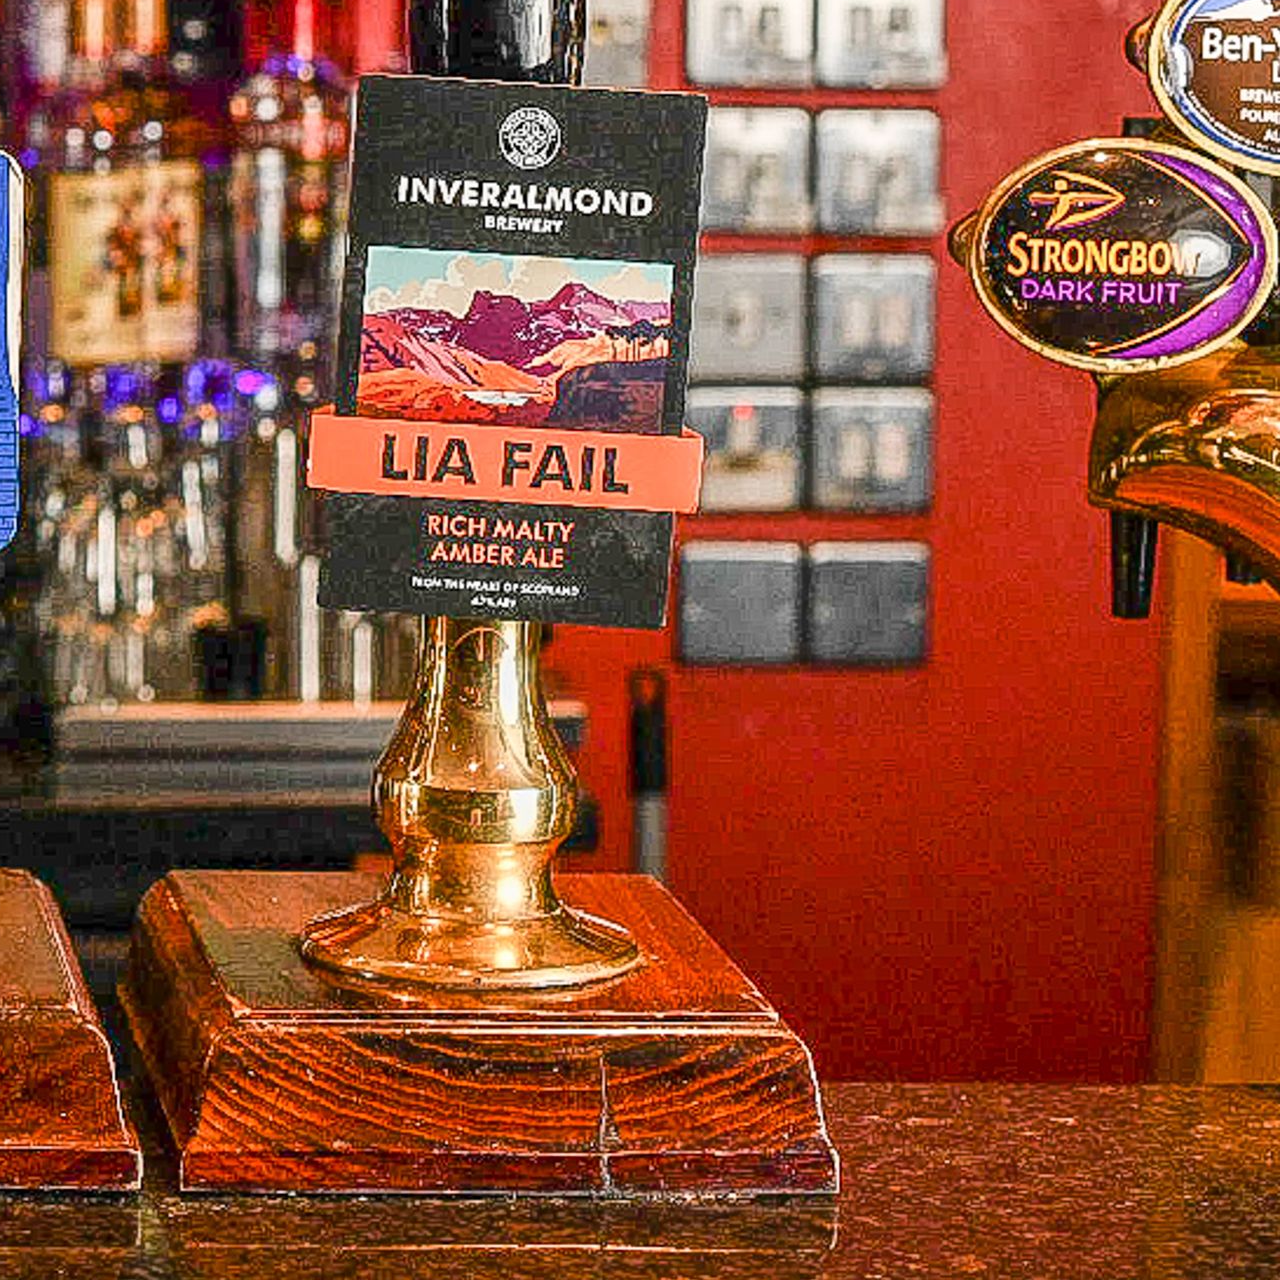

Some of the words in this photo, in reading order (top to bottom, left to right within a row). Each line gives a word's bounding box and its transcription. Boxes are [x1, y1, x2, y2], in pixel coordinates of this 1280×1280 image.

[396, 174, 654, 218] INVERALMOND
[484, 214, 564, 234] BREWERY
[1006, 230, 1201, 276] STRONGBOW
[1021, 278, 1093, 303] DARK
[1101, 280, 1183, 305] FRUIT
[382, 433, 477, 486] LIA
[501, 439, 629, 495] FAIL
[427, 514, 485, 538] RICH
[491, 517, 576, 543] MALTY
[430, 541, 515, 566] AMBER
[520, 546, 565, 569] ALE
